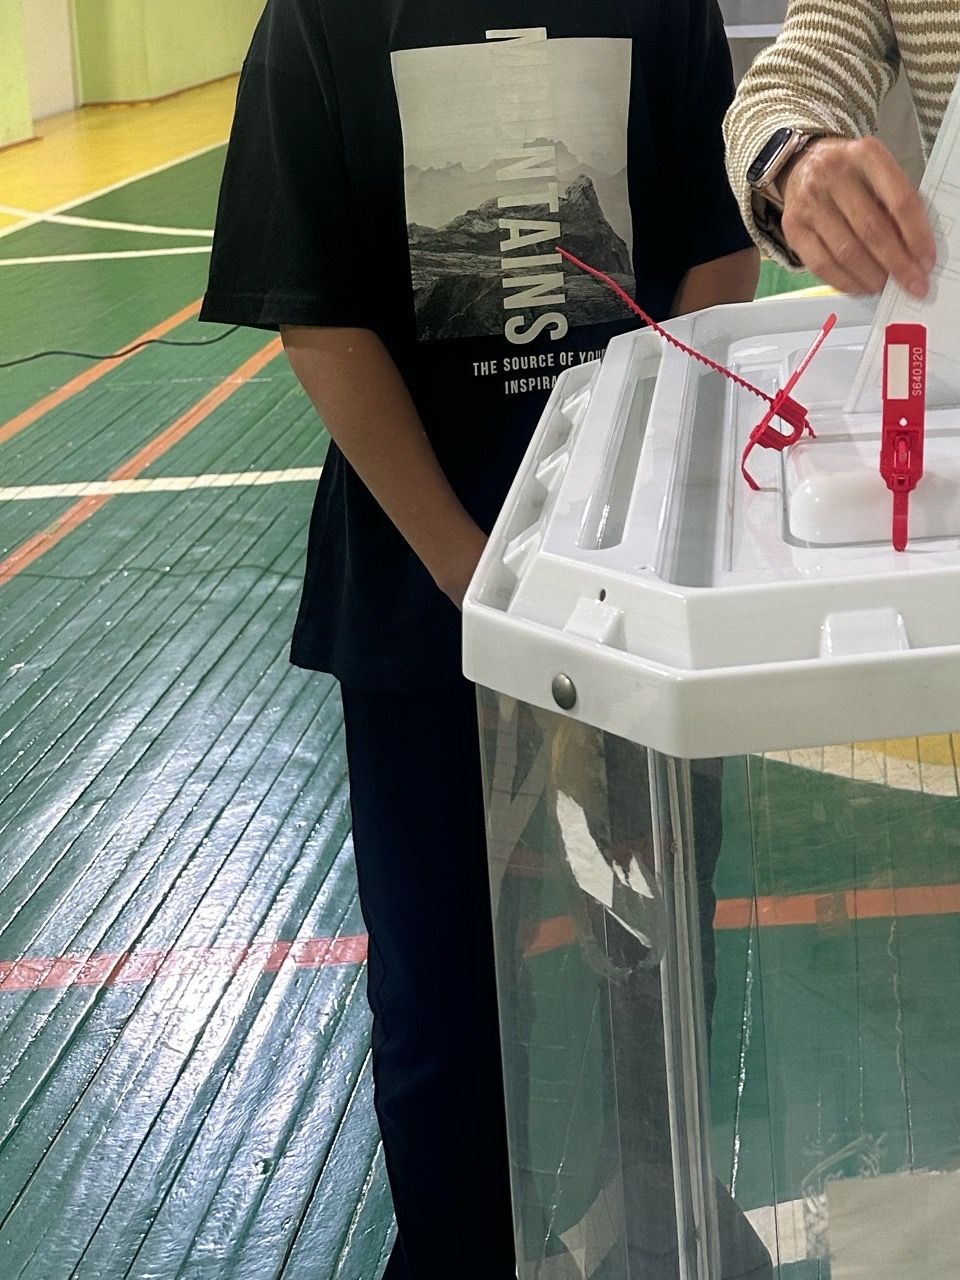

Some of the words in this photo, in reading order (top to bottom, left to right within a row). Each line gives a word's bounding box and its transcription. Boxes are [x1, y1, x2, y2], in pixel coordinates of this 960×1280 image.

[473, 360, 498, 376] THE
[503, 353, 555, 371] SOURCE
[559, 352, 574, 366] OF
[912, 347, 923, 396] S640320
